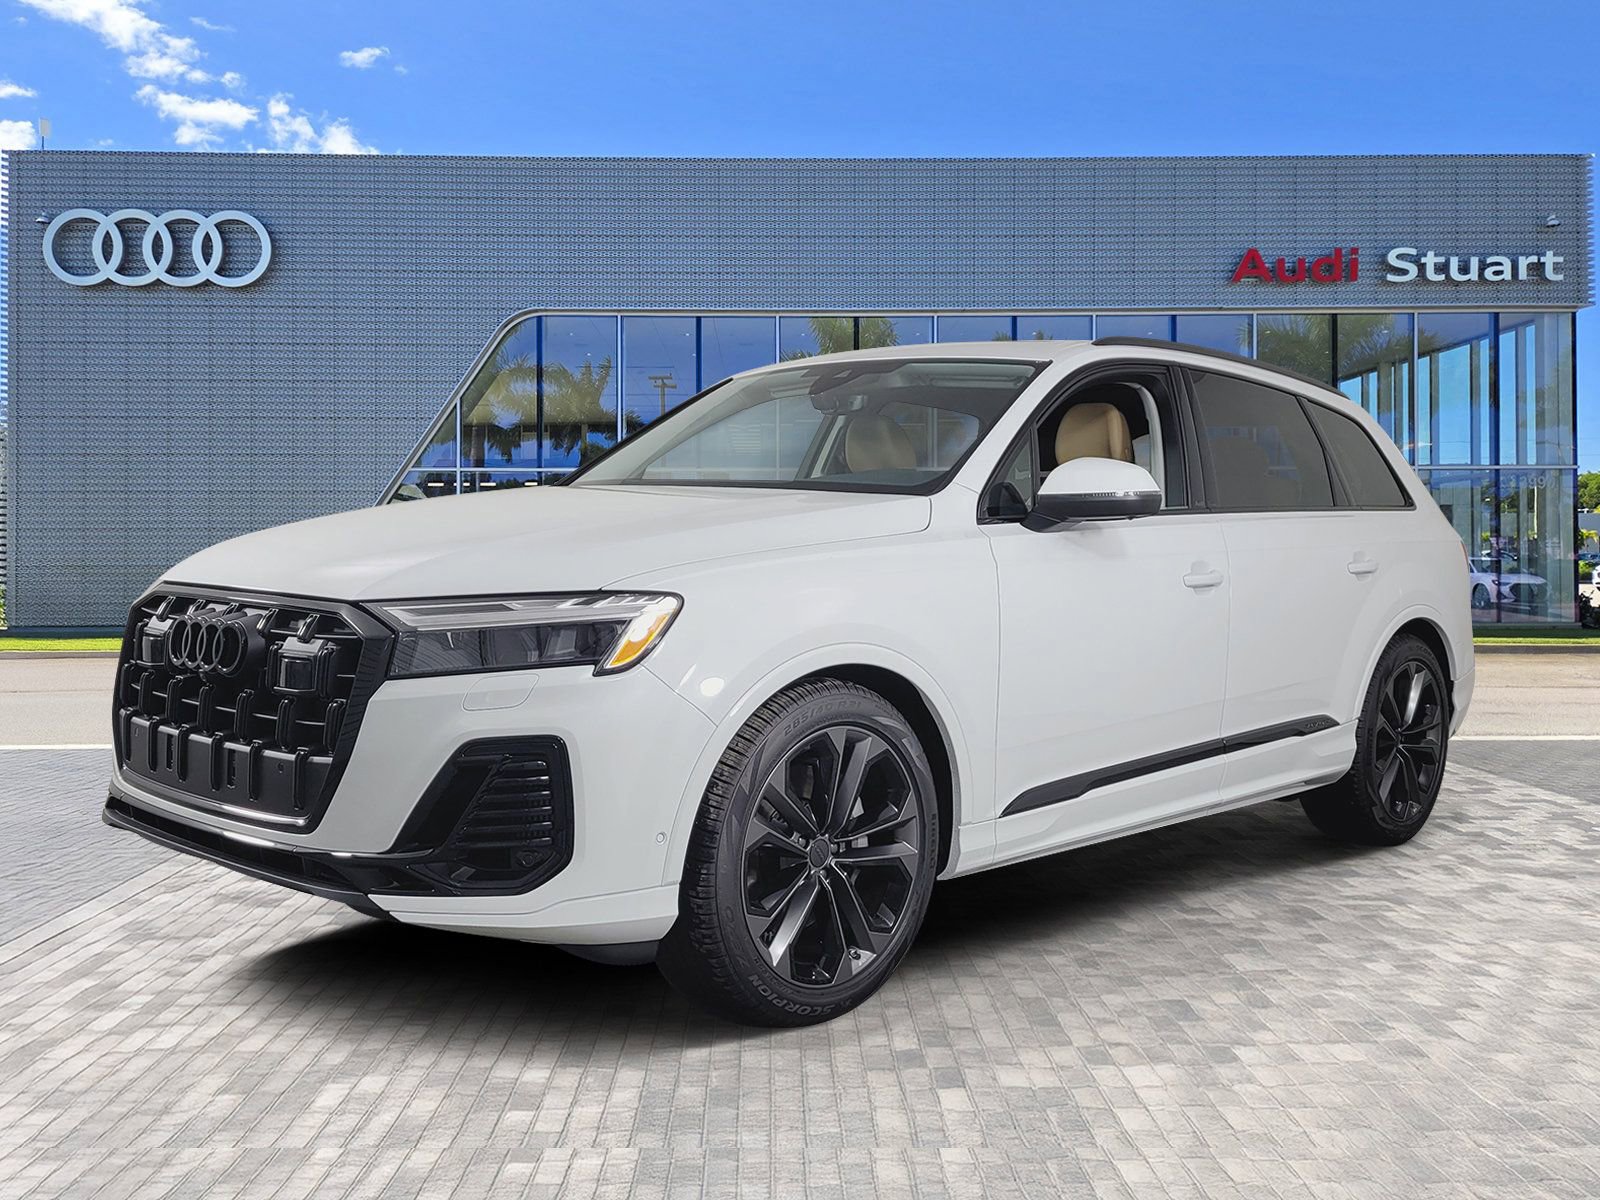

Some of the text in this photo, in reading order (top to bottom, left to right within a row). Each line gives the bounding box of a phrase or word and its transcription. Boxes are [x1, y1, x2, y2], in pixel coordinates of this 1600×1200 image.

[1232, 247, 1564, 283] Audi Stuart
[748, 974, 835, 1016] SCORPION
